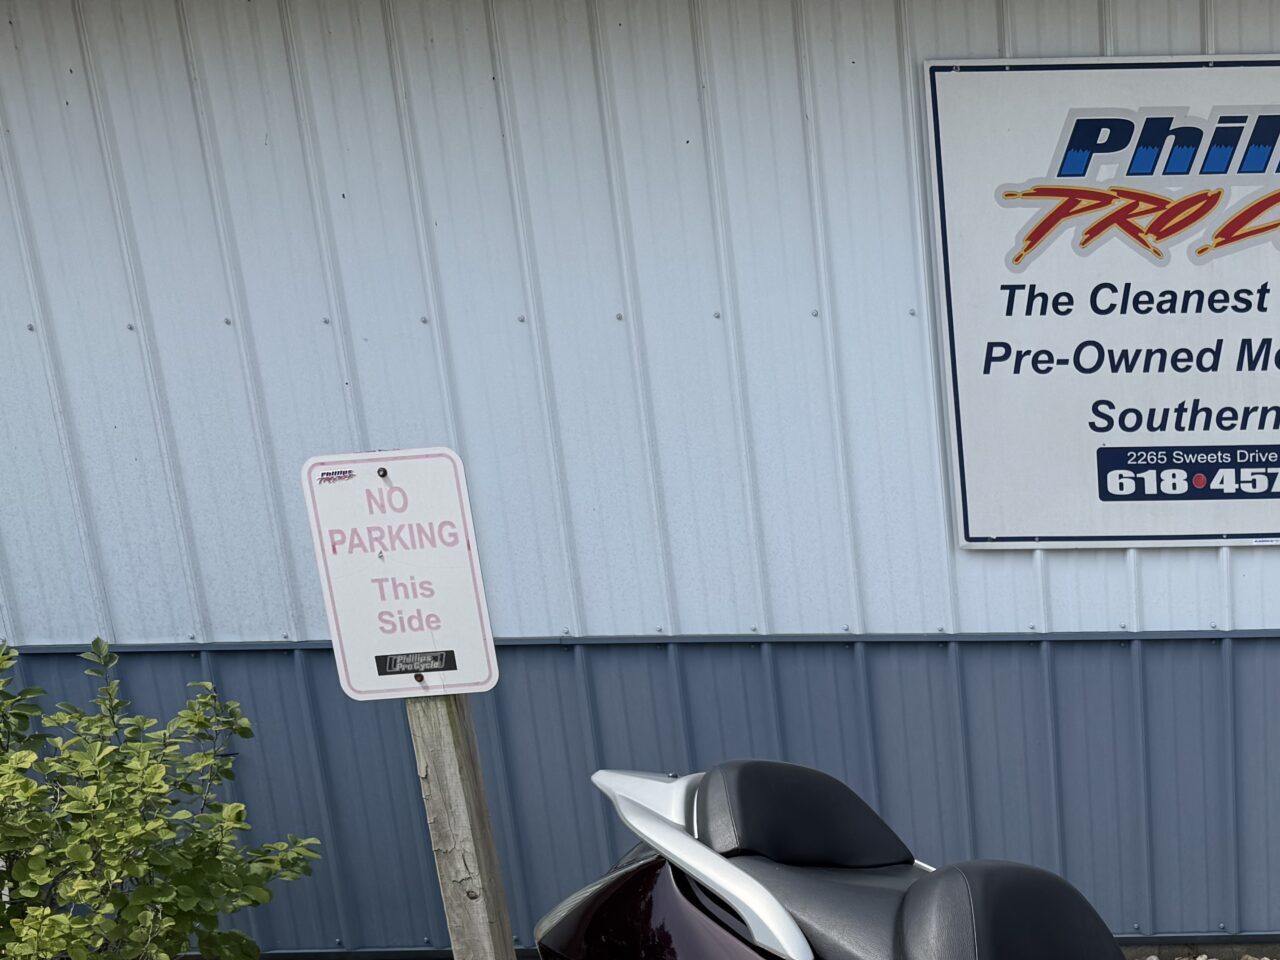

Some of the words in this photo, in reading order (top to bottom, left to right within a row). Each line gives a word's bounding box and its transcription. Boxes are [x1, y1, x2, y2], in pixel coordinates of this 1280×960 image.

[1003, 182, 1224, 265] PRO
[999, 284, 1074, 316] The
[1088, 281, 1269, 314] Cleanest
[983, 339, 1223, 374] Pre-Owned
[1127, 451, 1167, 464] 2265
[1172, 449, 1231, 463] Sweets
[1236, 448, 1278, 463] Drive
[365, 486, 409, 515] NO
[328, 521, 460, 555] PARKING
[371, 576, 435, 601] This
[377, 609, 442, 635] Side
